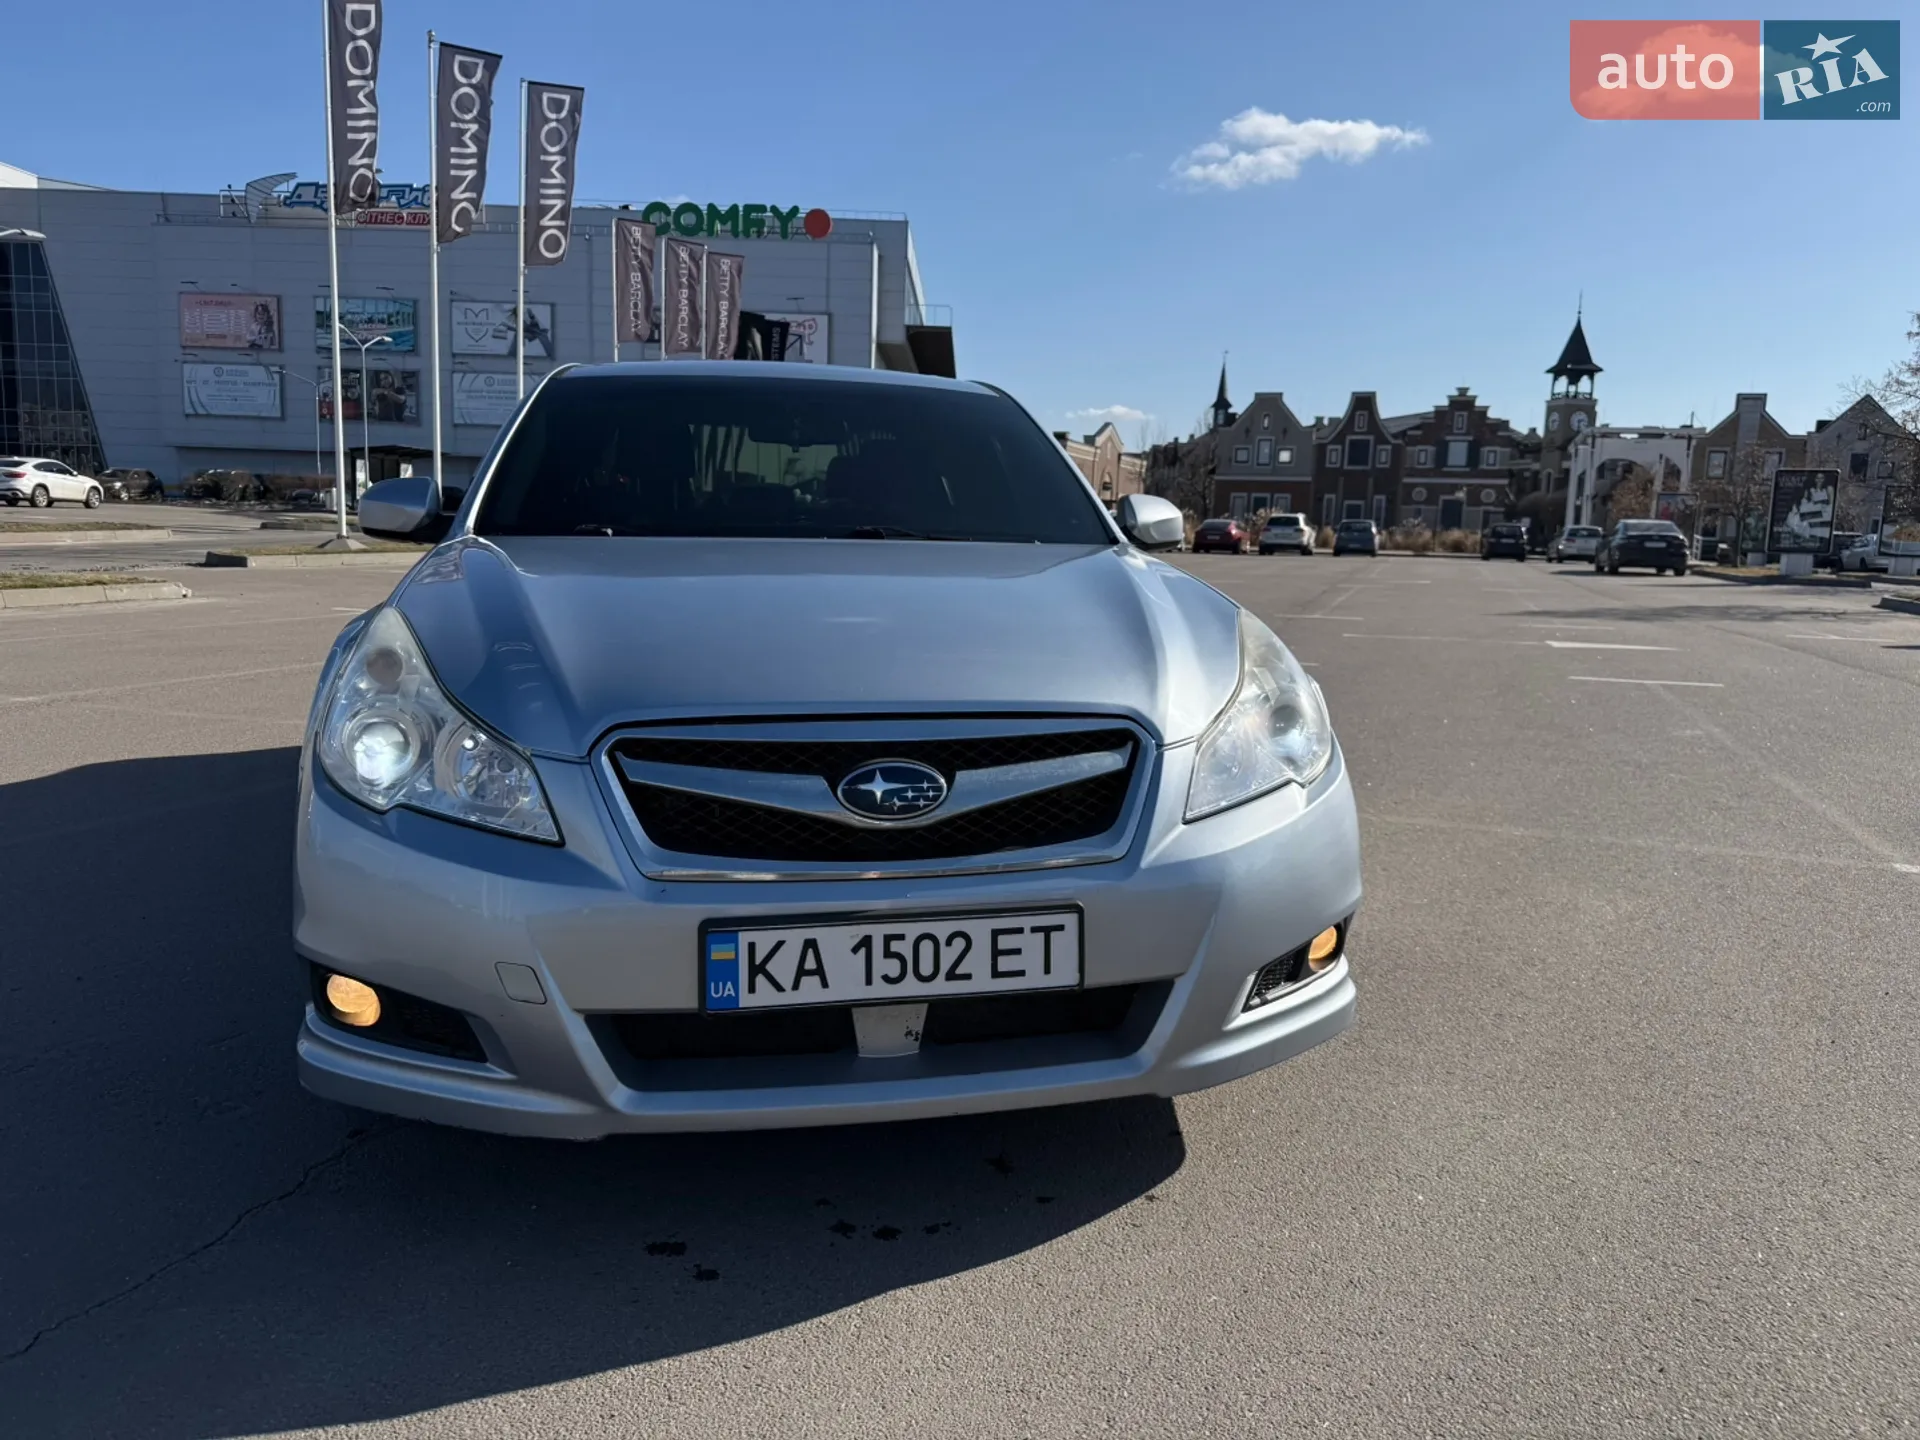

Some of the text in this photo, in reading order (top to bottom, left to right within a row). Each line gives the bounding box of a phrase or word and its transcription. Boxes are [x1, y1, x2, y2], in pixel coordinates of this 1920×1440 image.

[345, 2, 377, 203] DOMINO
[450, 54, 485, 233] DOMINO
[538, 91, 571, 259] DOMINO
[357, 212, 431, 225] ФІТНЕС КЛУ
[630, 226, 642, 265] BETTY
[641, 201, 800, 240] COMFY
[677, 245, 691, 348] BETTY BARCLAY
[717, 258, 731, 359] BETTY BARCLAY
[710, 981, 736, 999] UA
[746, 923, 1066, 995] KA 1502 ET
